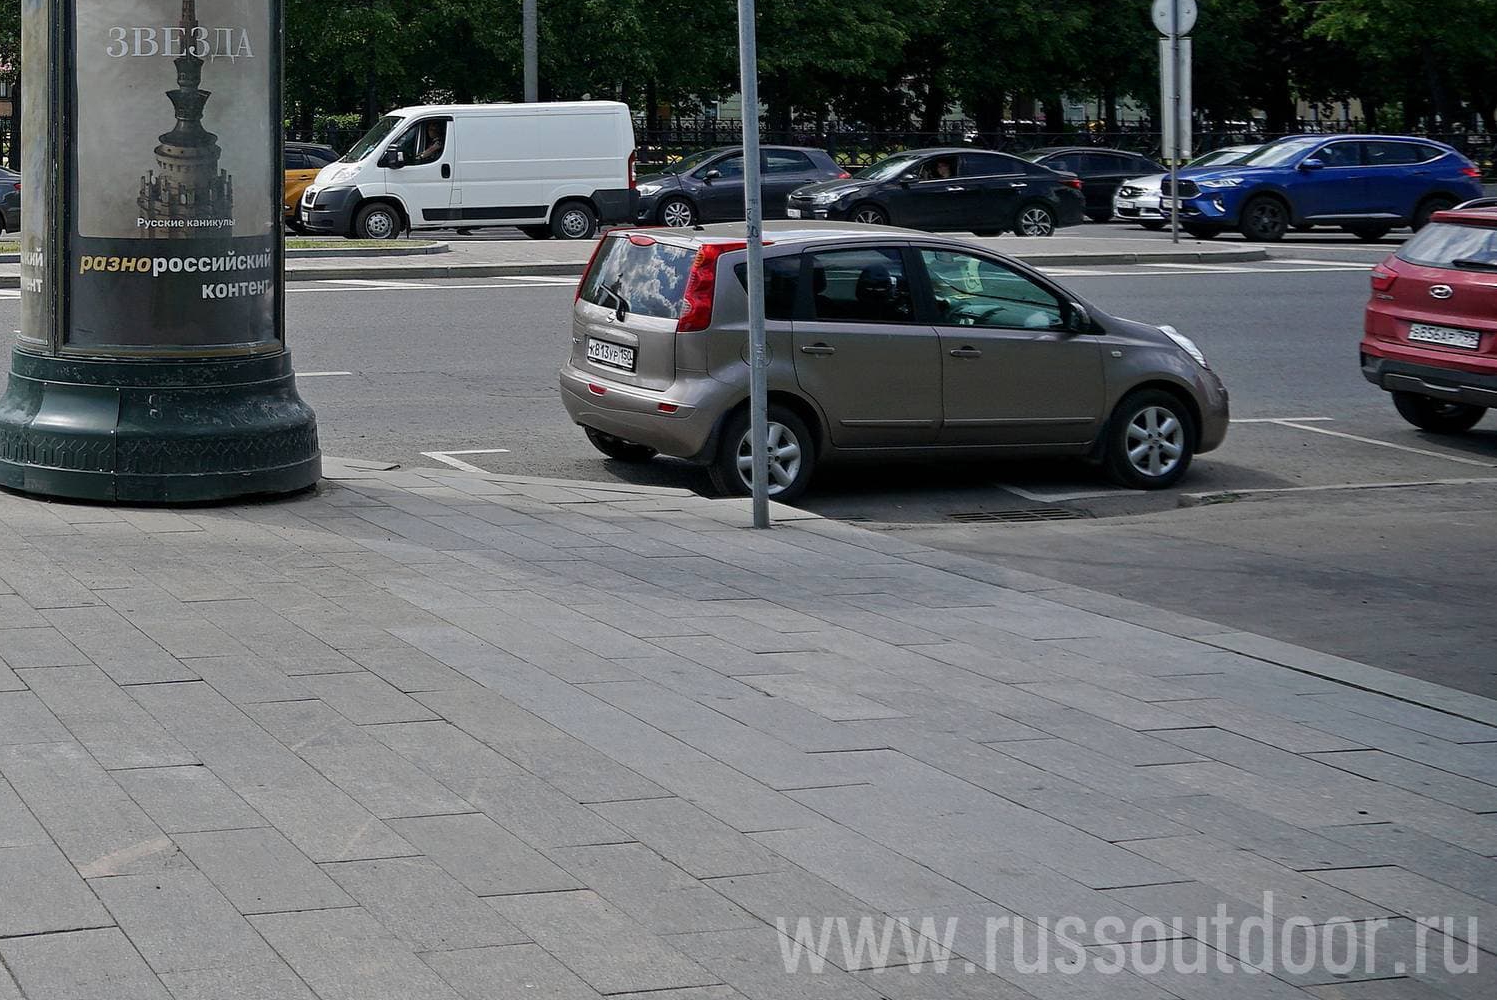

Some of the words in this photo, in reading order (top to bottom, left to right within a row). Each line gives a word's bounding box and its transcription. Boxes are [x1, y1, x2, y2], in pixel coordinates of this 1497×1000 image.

[107, 26, 255, 65] ЗВЕЗДА
[136, 217, 185, 230] Русские
[187, 218, 236, 229] каникулы
[79, 248, 272, 277] разнороссийский
